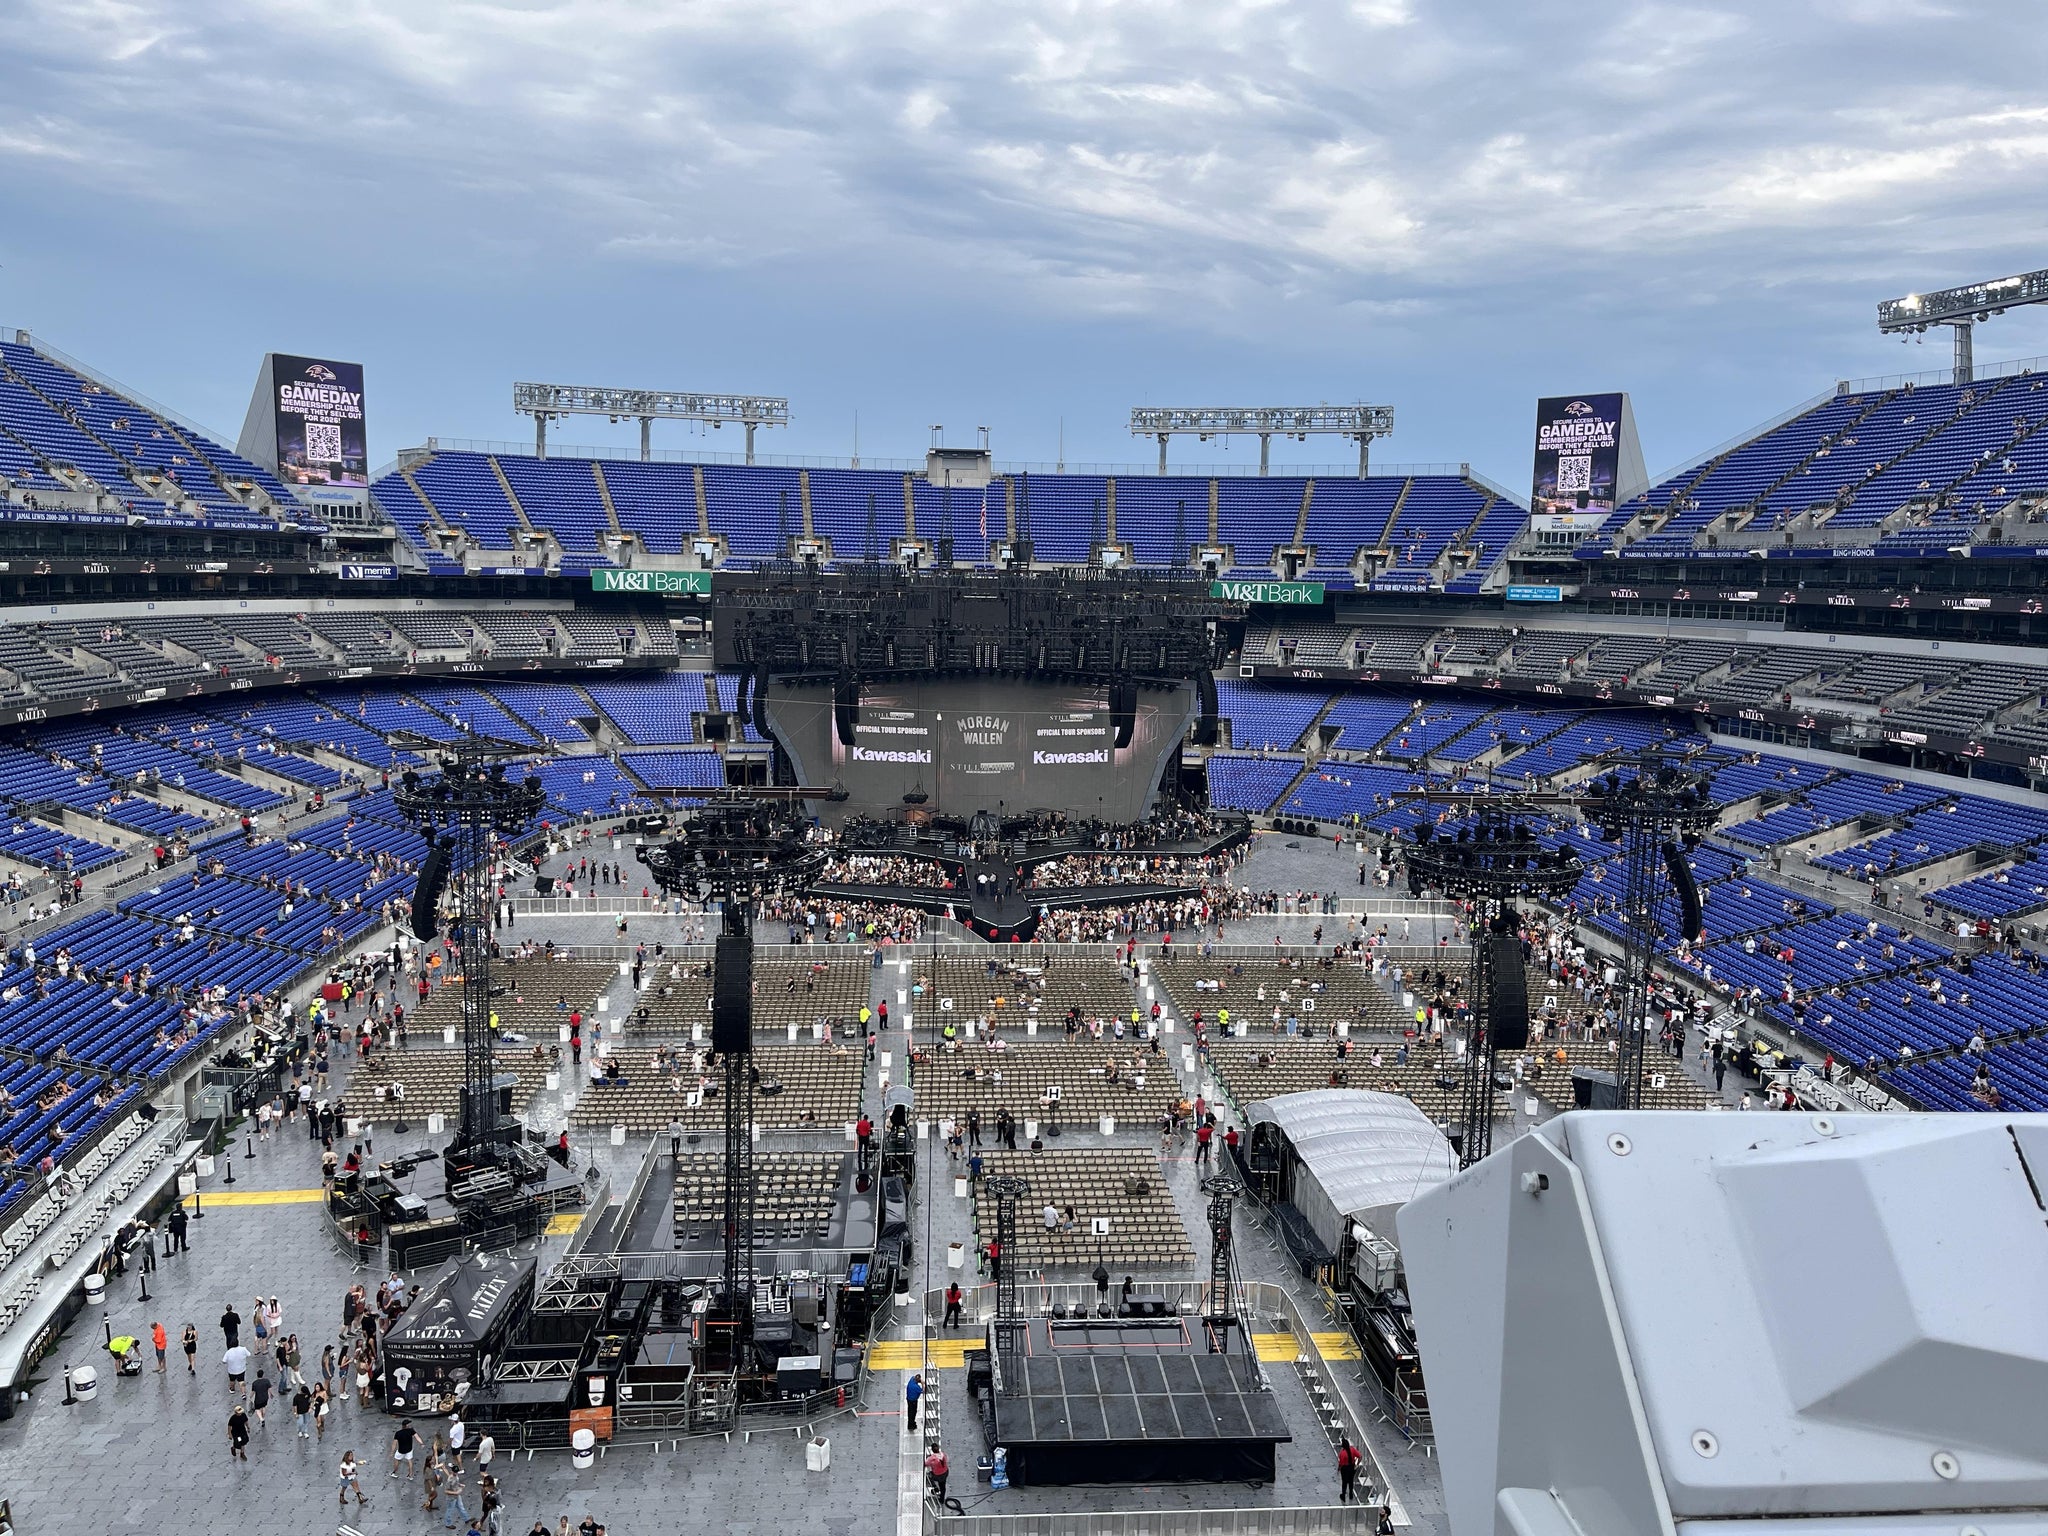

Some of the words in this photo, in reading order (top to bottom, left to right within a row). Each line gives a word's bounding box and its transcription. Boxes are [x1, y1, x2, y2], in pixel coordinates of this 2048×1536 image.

[294, 380, 316, 388] SECURE
[317, 383, 338, 391] ACCESS
[280, 384, 361, 406] GAMEDAY
[281, 398, 334, 410] MEMBERSHIP
[280, 405, 309, 413] BEFORE
[310, 408, 329, 416] THEY
[329, 410, 347, 418] SELL
[1540, 421, 1616, 438] GAMEDAY
[1539, 435, 1587, 444] MEMBERSHIP
[1538, 443, 1563, 451] BEFORE
[31, 513, 46, 521] LEWIS
[1832, 549, 1848, 557] RING
[1851, 549, 1875, 557] HONOR
[364, 566, 392, 575] merritt
[603, 571, 654, 590] M&T
[655, 572, 701, 592] Bank
[1220, 583, 1268, 602] M&T
[1268, 584, 1313, 603] Bank
[1610, 590, 1640, 599] WALLEN
[230, 680, 253, 690] WALLEN
[16, 708, 47, 722] WALLEN
[956, 715, 1010, 733] MORGAN
[855, 725, 880, 733] OFFICIAL
[881, 726, 897, 734] TOUR
[897, 727, 928, 735] SPONSORS
[1036, 728, 1061, 737] OFFICIAL
[1060, 728, 1077, 736] TOUR
[1076, 727, 1106, 736] SPONSORS
[963, 732, 1003, 745] WALLEN
[852, 746, 931, 764] Kawasaki
[1033, 749, 1109, 764] Kawasaki
[942, 1000, 950, 1009] C
[1305, 1001, 1312, 1010] B
[1546, 997, 1555, 1006] A
[1654, 1076, 1663, 1086] F
[395, 1085, 403, 1097] K
[1049, 1088, 1059, 1099] H
[691, 1094, 698, 1105] J
[1096, 1221, 1105, 1233] L
[467, 1274, 508, 1320] WALLEN
[406, 1329, 465, 1339] WALLEN
